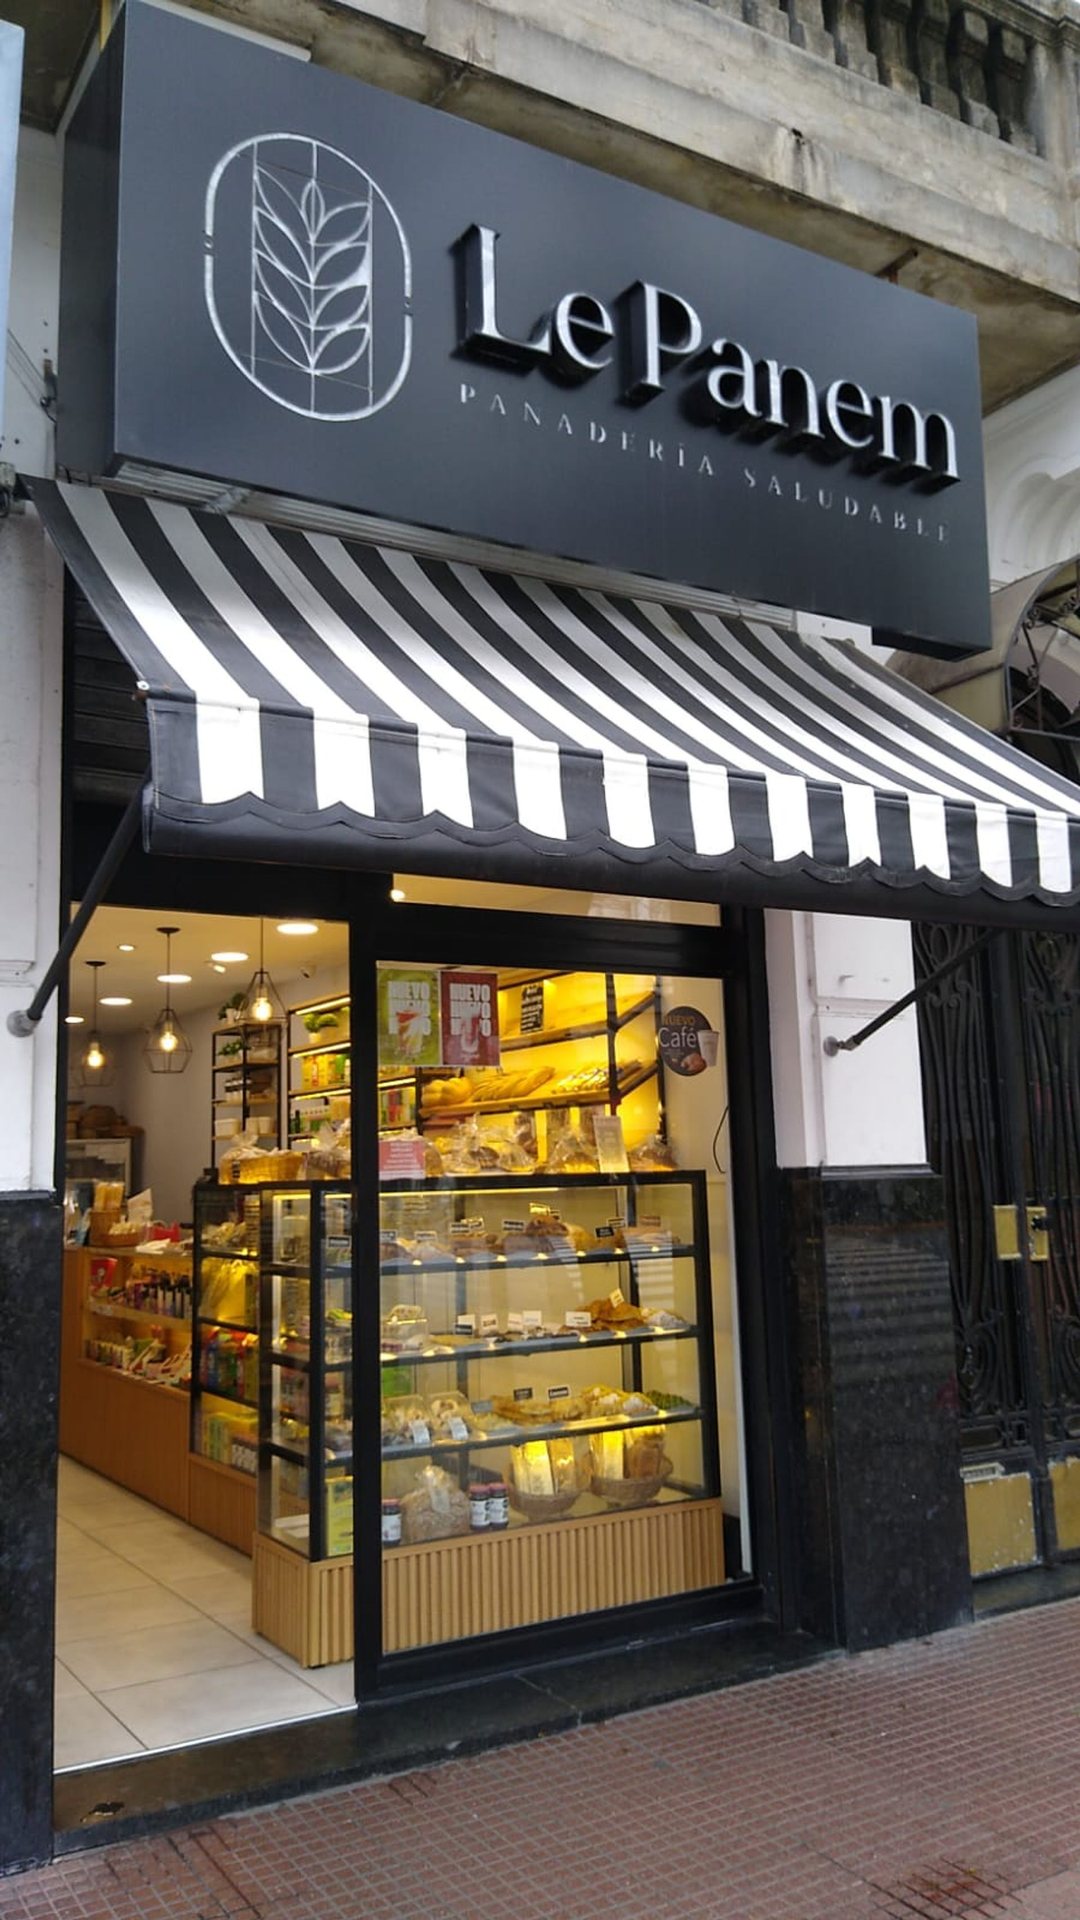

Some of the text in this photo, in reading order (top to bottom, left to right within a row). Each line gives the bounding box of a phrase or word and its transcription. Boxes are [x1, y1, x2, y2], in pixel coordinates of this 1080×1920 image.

[639, 280, 961, 482] Panem
[743, 467, 951, 542] SALUDABLE
[449, 983, 491, 1001] NUEVO
[658, 1026, 697, 1048] Café
